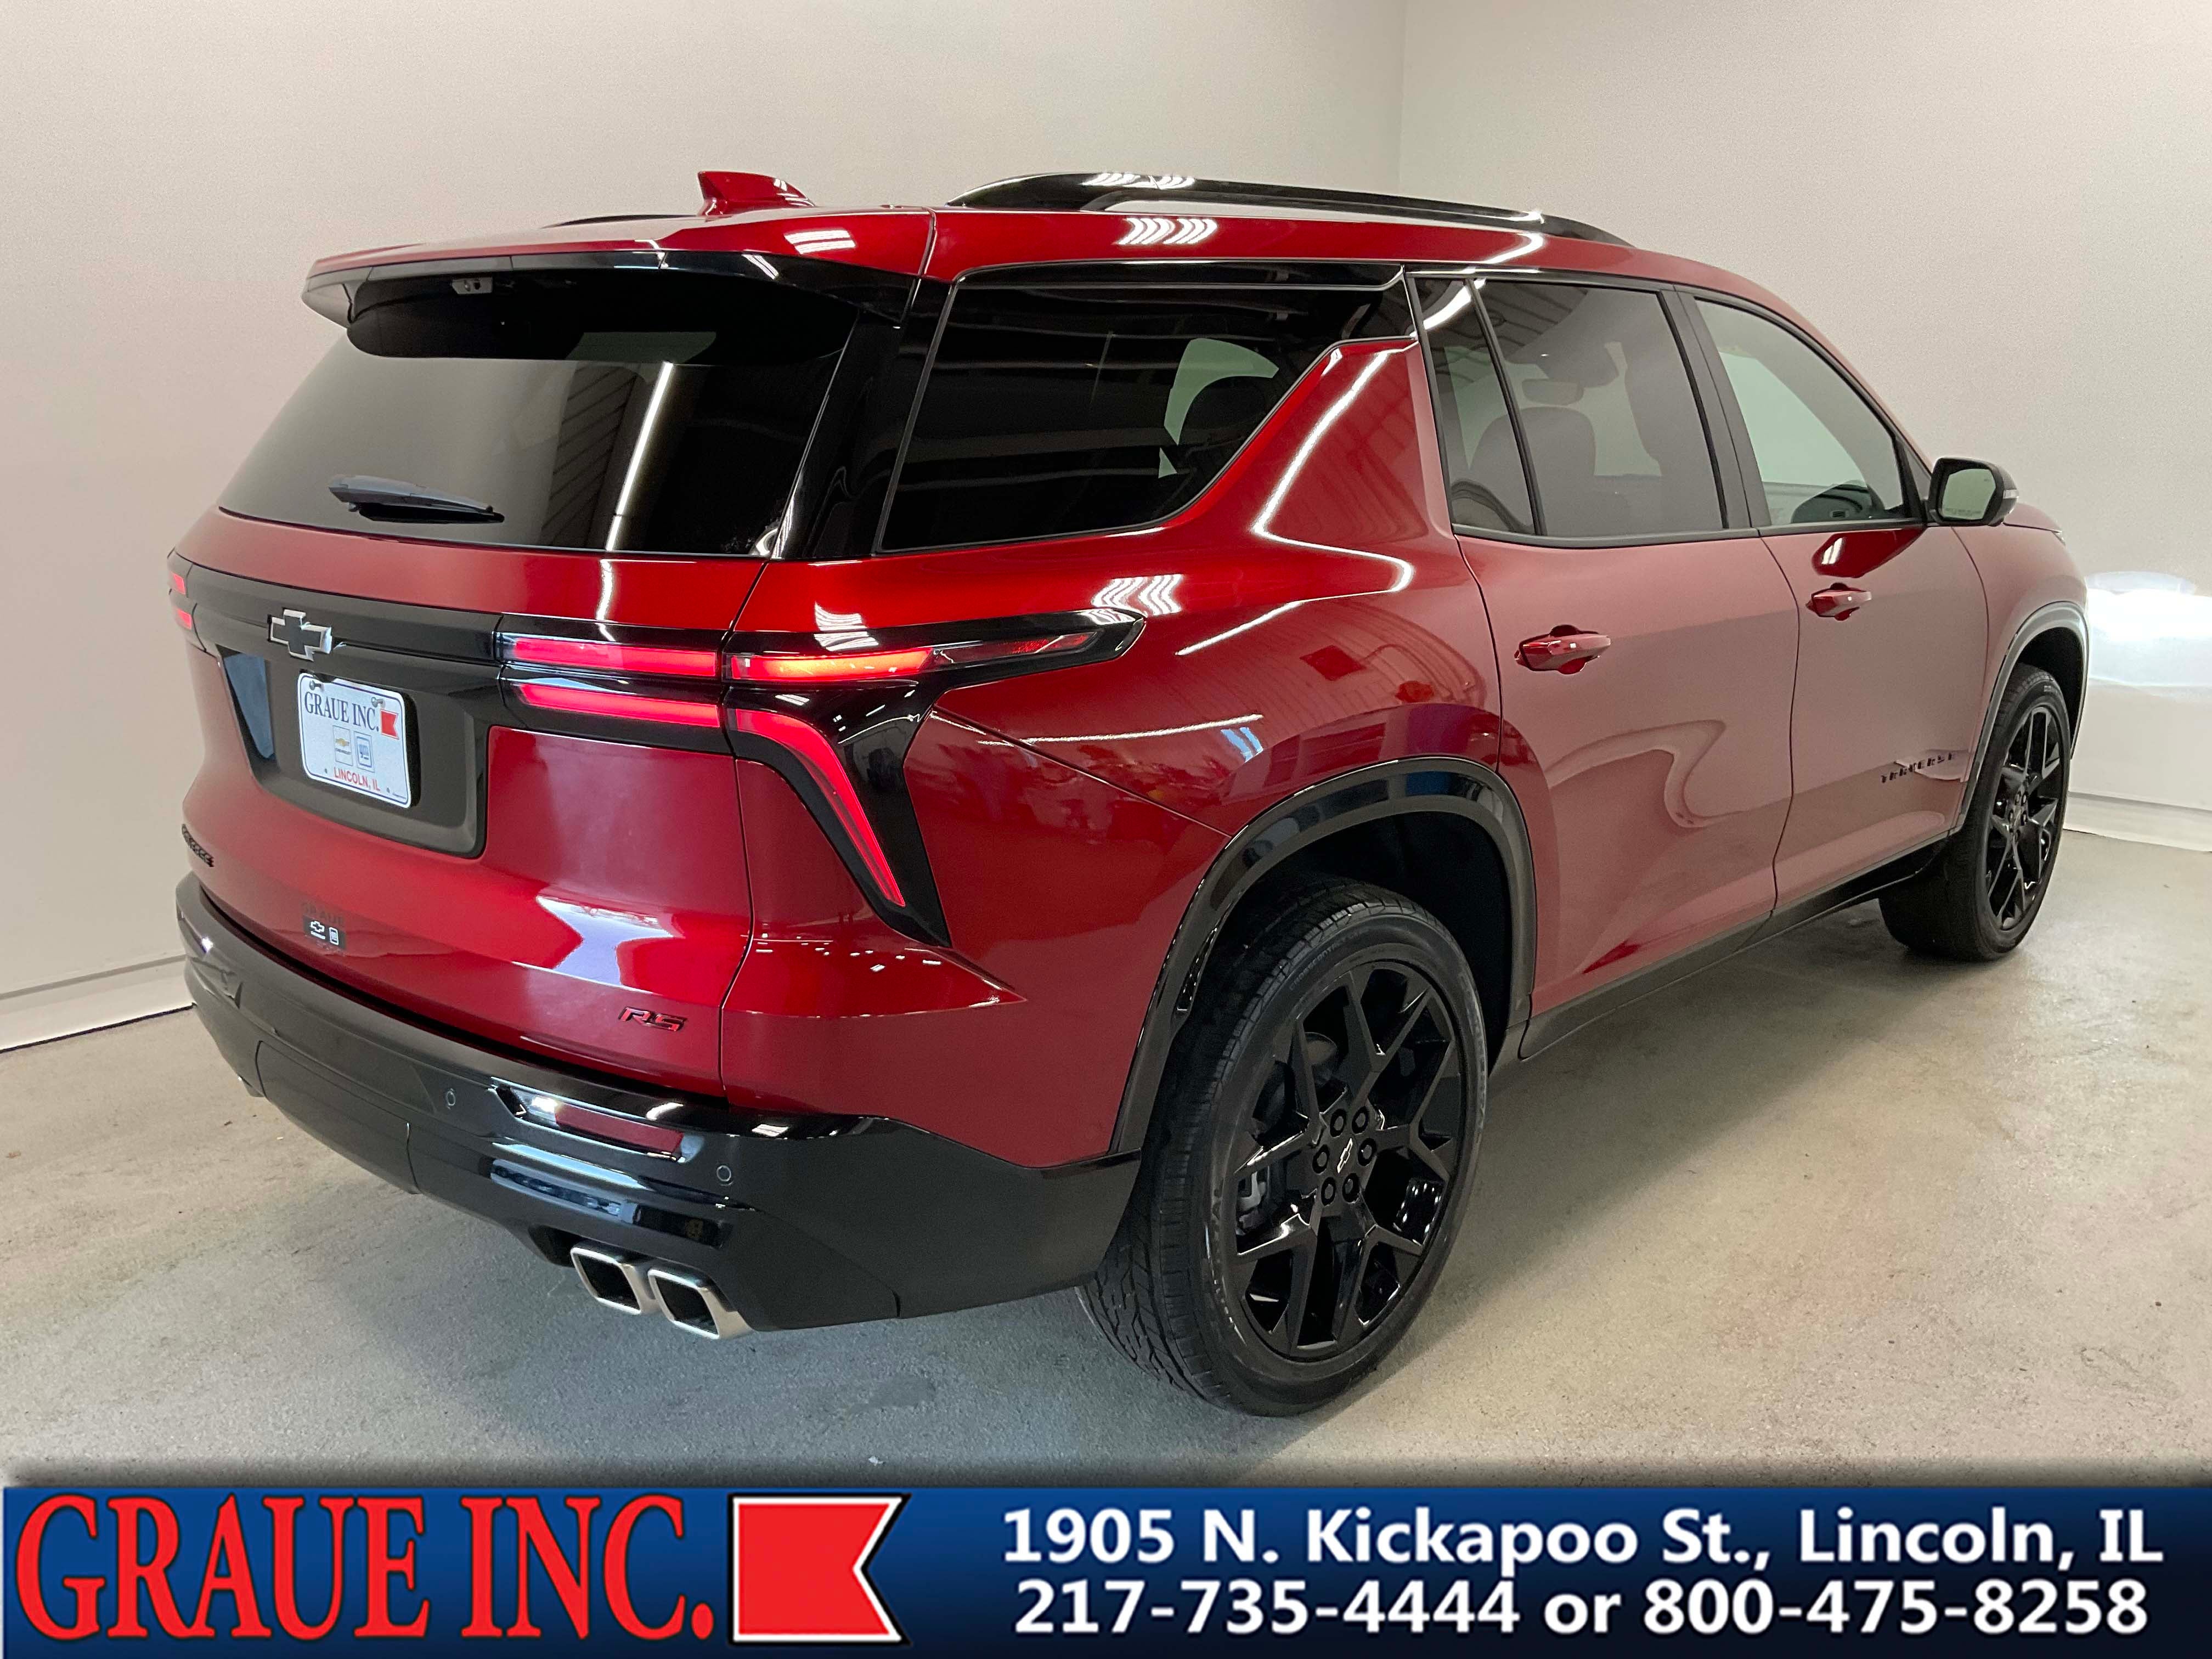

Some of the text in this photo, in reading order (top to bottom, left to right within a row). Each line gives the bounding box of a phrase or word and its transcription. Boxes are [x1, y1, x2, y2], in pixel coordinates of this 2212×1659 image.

[304, 691, 379, 732] GRAUE INC.
[334, 767, 381, 791] LINCOLN, IL
[618, 1006, 687, 1031] RS
